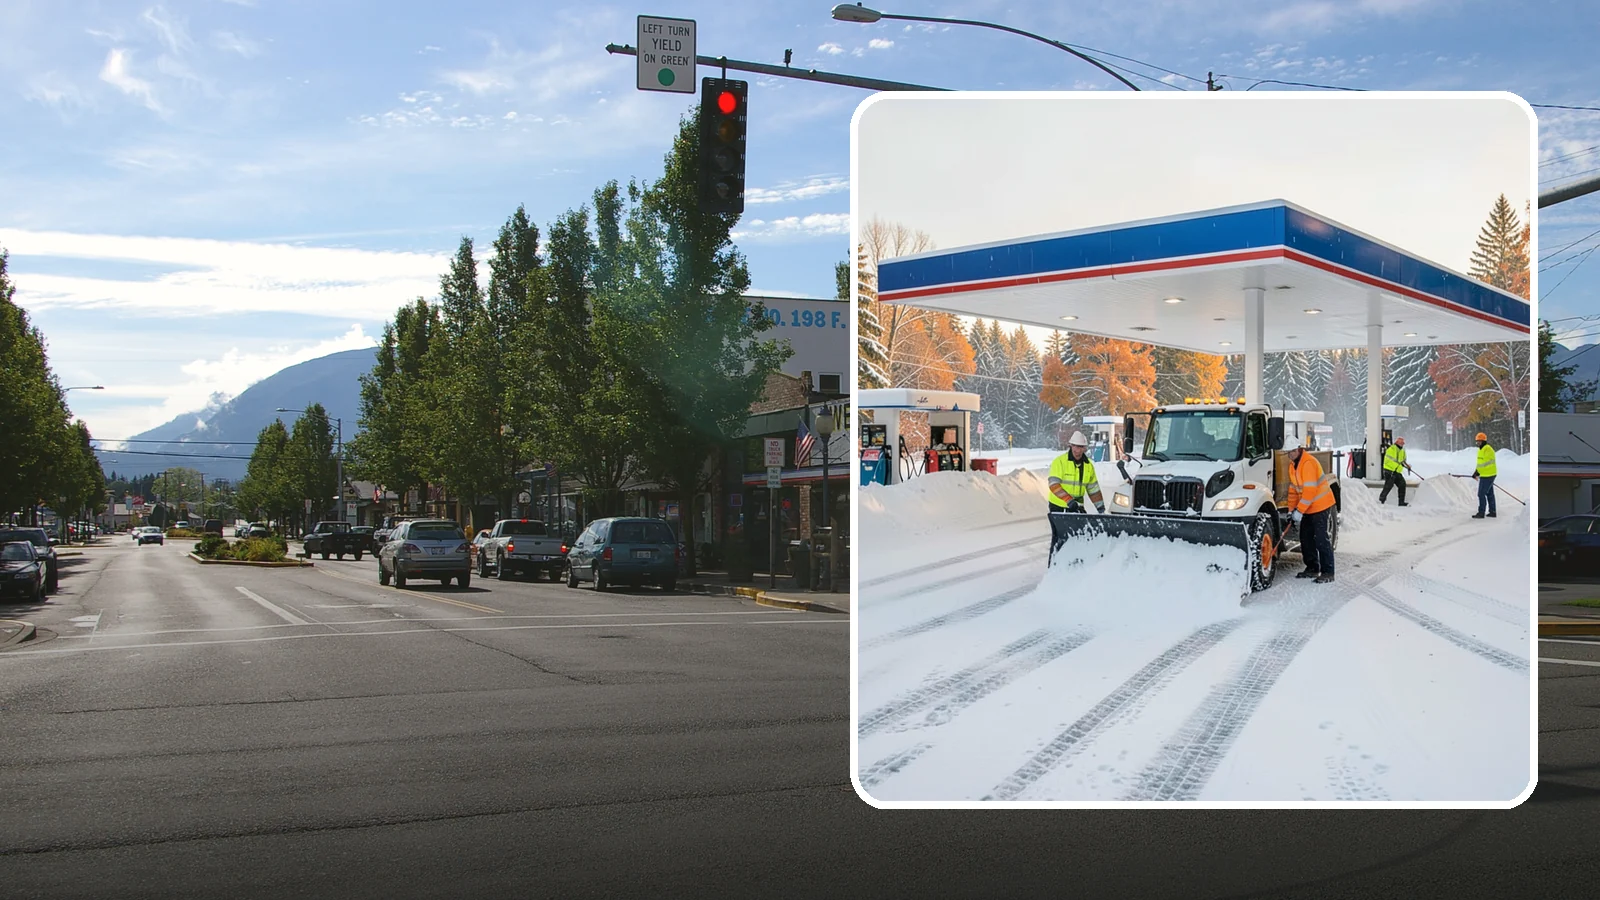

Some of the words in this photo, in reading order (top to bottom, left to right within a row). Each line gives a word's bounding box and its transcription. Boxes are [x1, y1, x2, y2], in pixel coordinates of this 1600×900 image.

[643, 24, 663, 34] LEFT
[668, 26, 690, 36] TURN
[652, 38, 682, 52] YIELD
[791, 310, 826, 328] 198
[831, 312, 846, 328] F.
